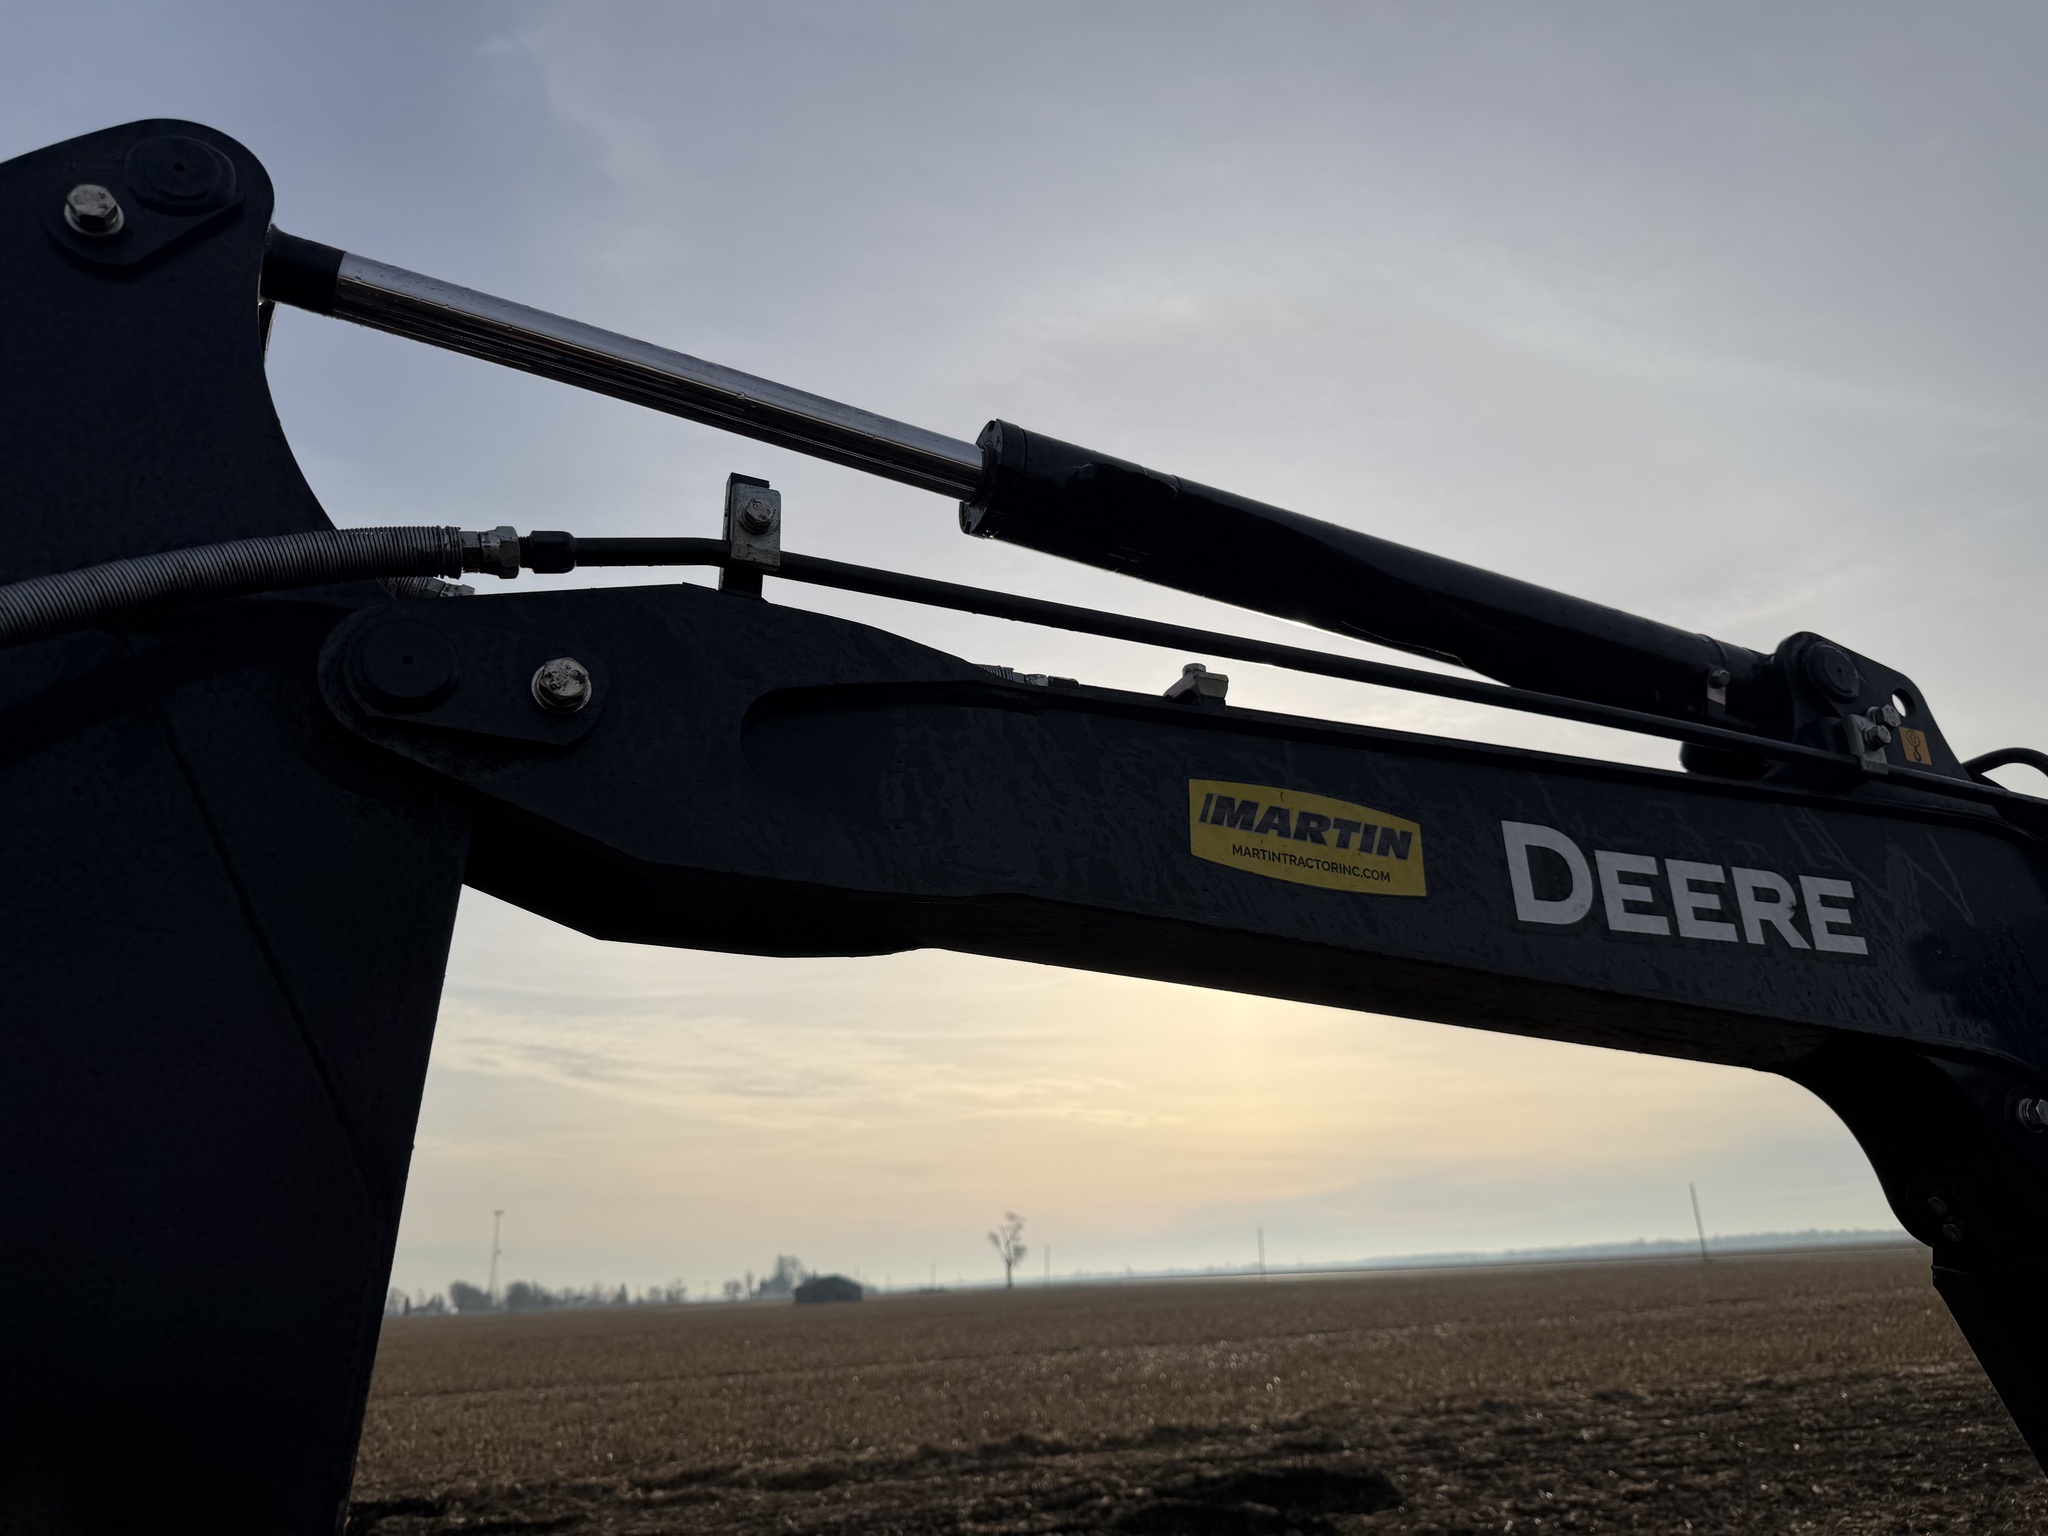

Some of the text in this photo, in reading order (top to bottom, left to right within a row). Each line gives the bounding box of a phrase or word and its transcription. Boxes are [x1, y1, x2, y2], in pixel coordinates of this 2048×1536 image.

[1208, 794, 1413, 860] MARTIN
[1232, 845, 1391, 882] MARTINTRACTORINC.COM
[1502, 820, 1868, 955] DEERE
